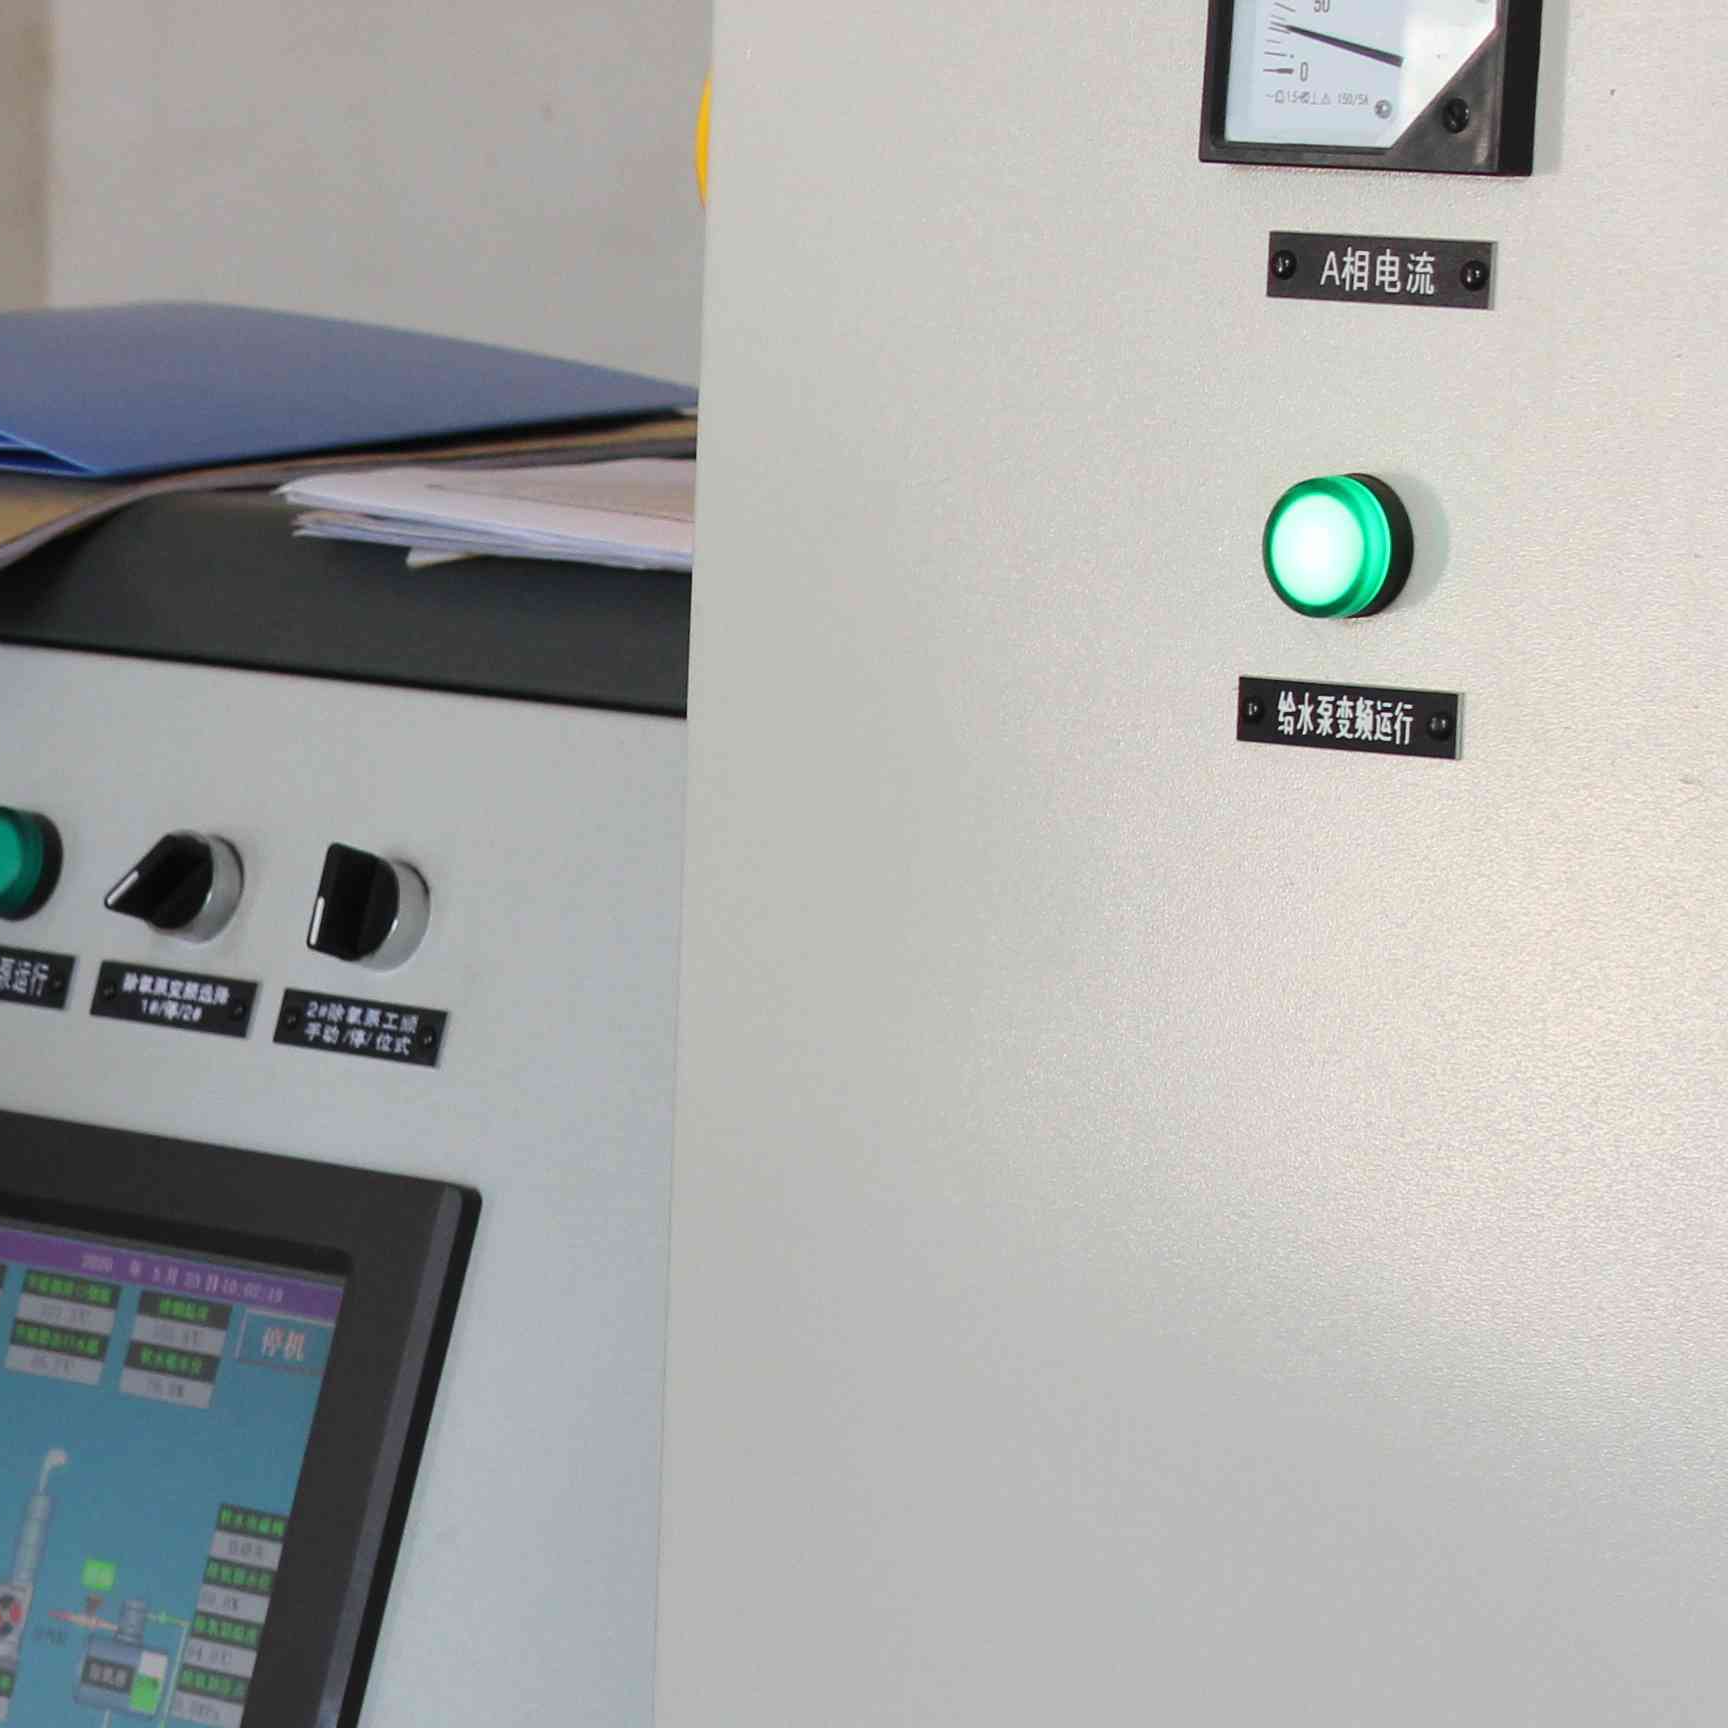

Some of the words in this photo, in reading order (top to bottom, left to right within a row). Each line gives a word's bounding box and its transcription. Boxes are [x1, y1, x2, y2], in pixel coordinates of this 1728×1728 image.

[1299, 61, 1309, 82] 0
[1320, 246, 1436, 296] A相电流
[1277, 690, 1414, 745] 给水泵变频运行
